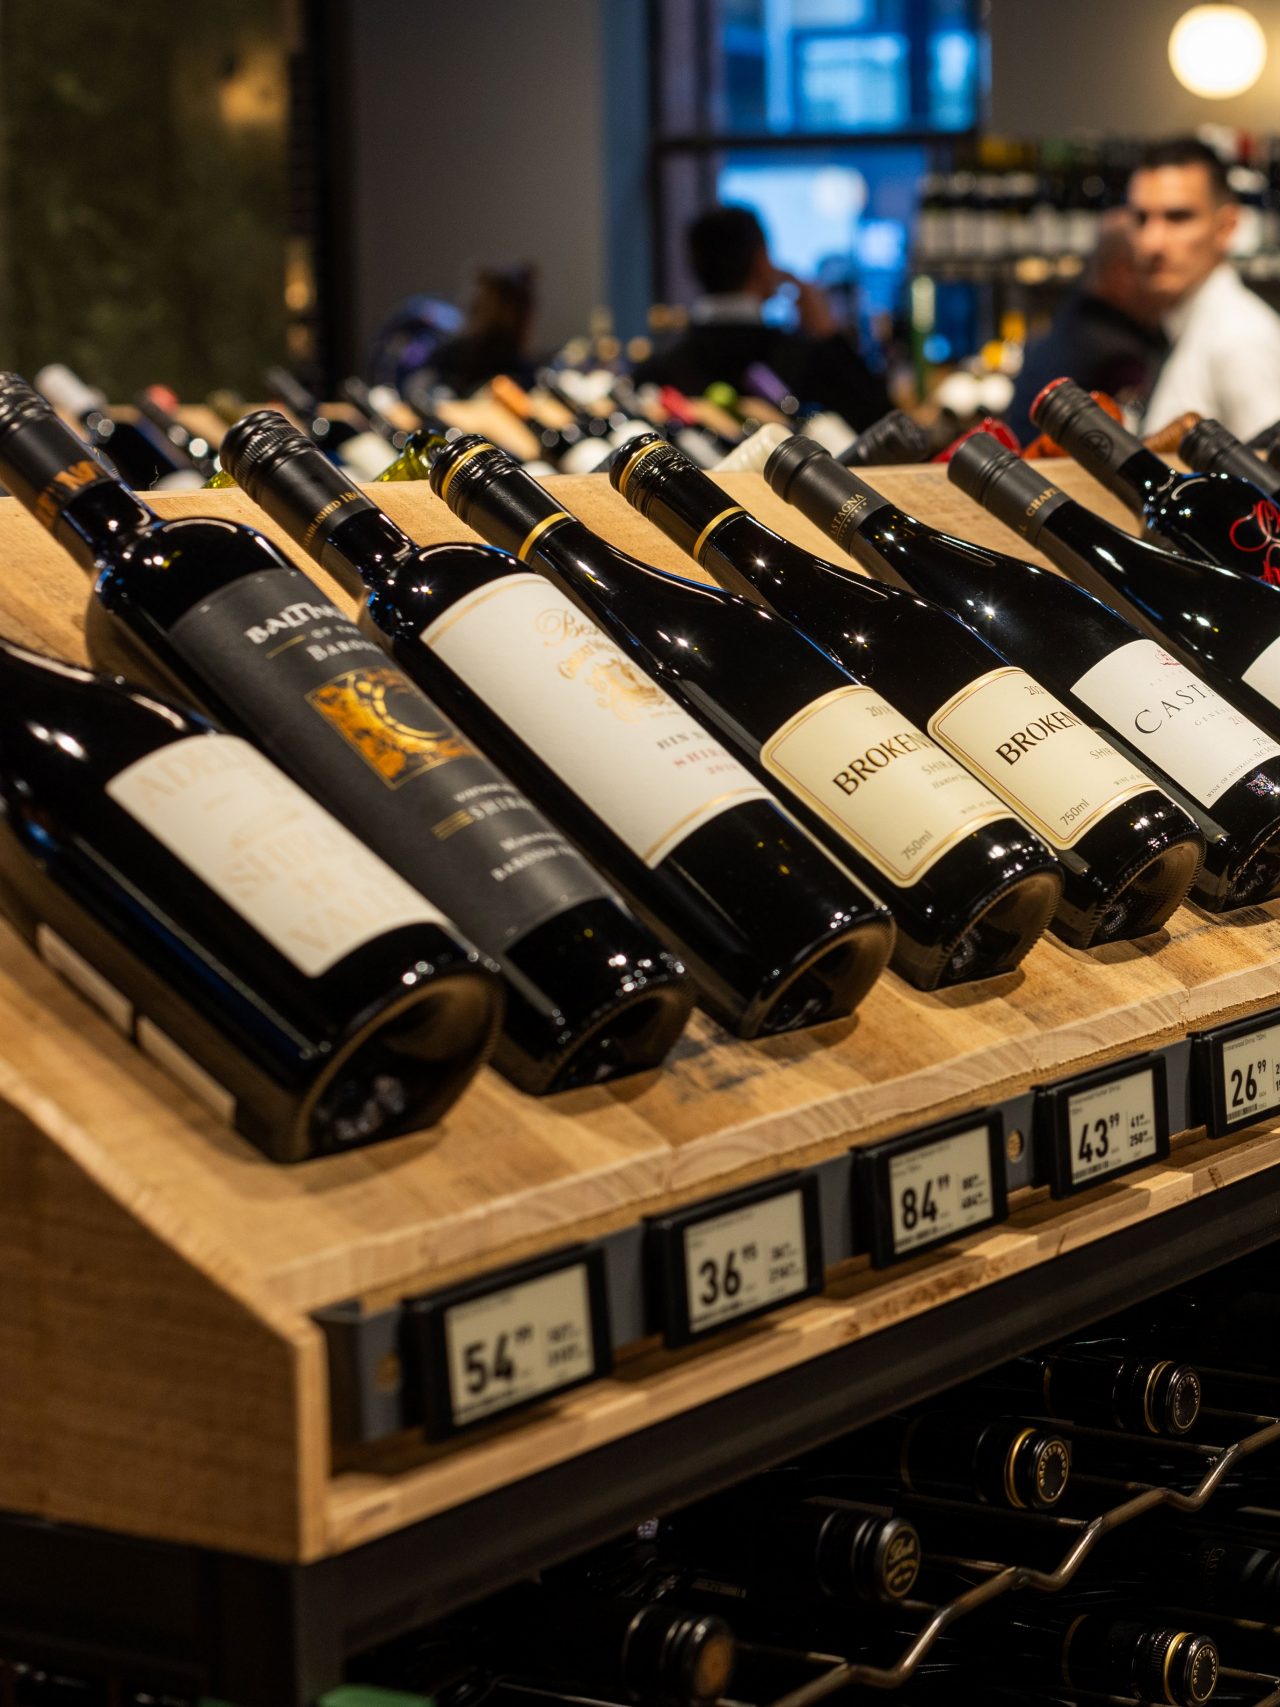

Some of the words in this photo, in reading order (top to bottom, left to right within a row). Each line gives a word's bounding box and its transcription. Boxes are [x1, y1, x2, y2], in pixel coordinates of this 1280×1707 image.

[1059, 798, 1090, 826] 750ml
[901, 829, 934, 861] 750ml
[1230, 1063, 1258, 1108] 26
[1257, 1059, 1267, 1074] 99
[1078, 1118, 1109, 1163] 43
[1109, 1112, 1120, 1129] 99
[902, 1179, 937, 1231] 84
[699, 1249, 742, 1307] 36
[462, 1332, 516, 1396] 54
